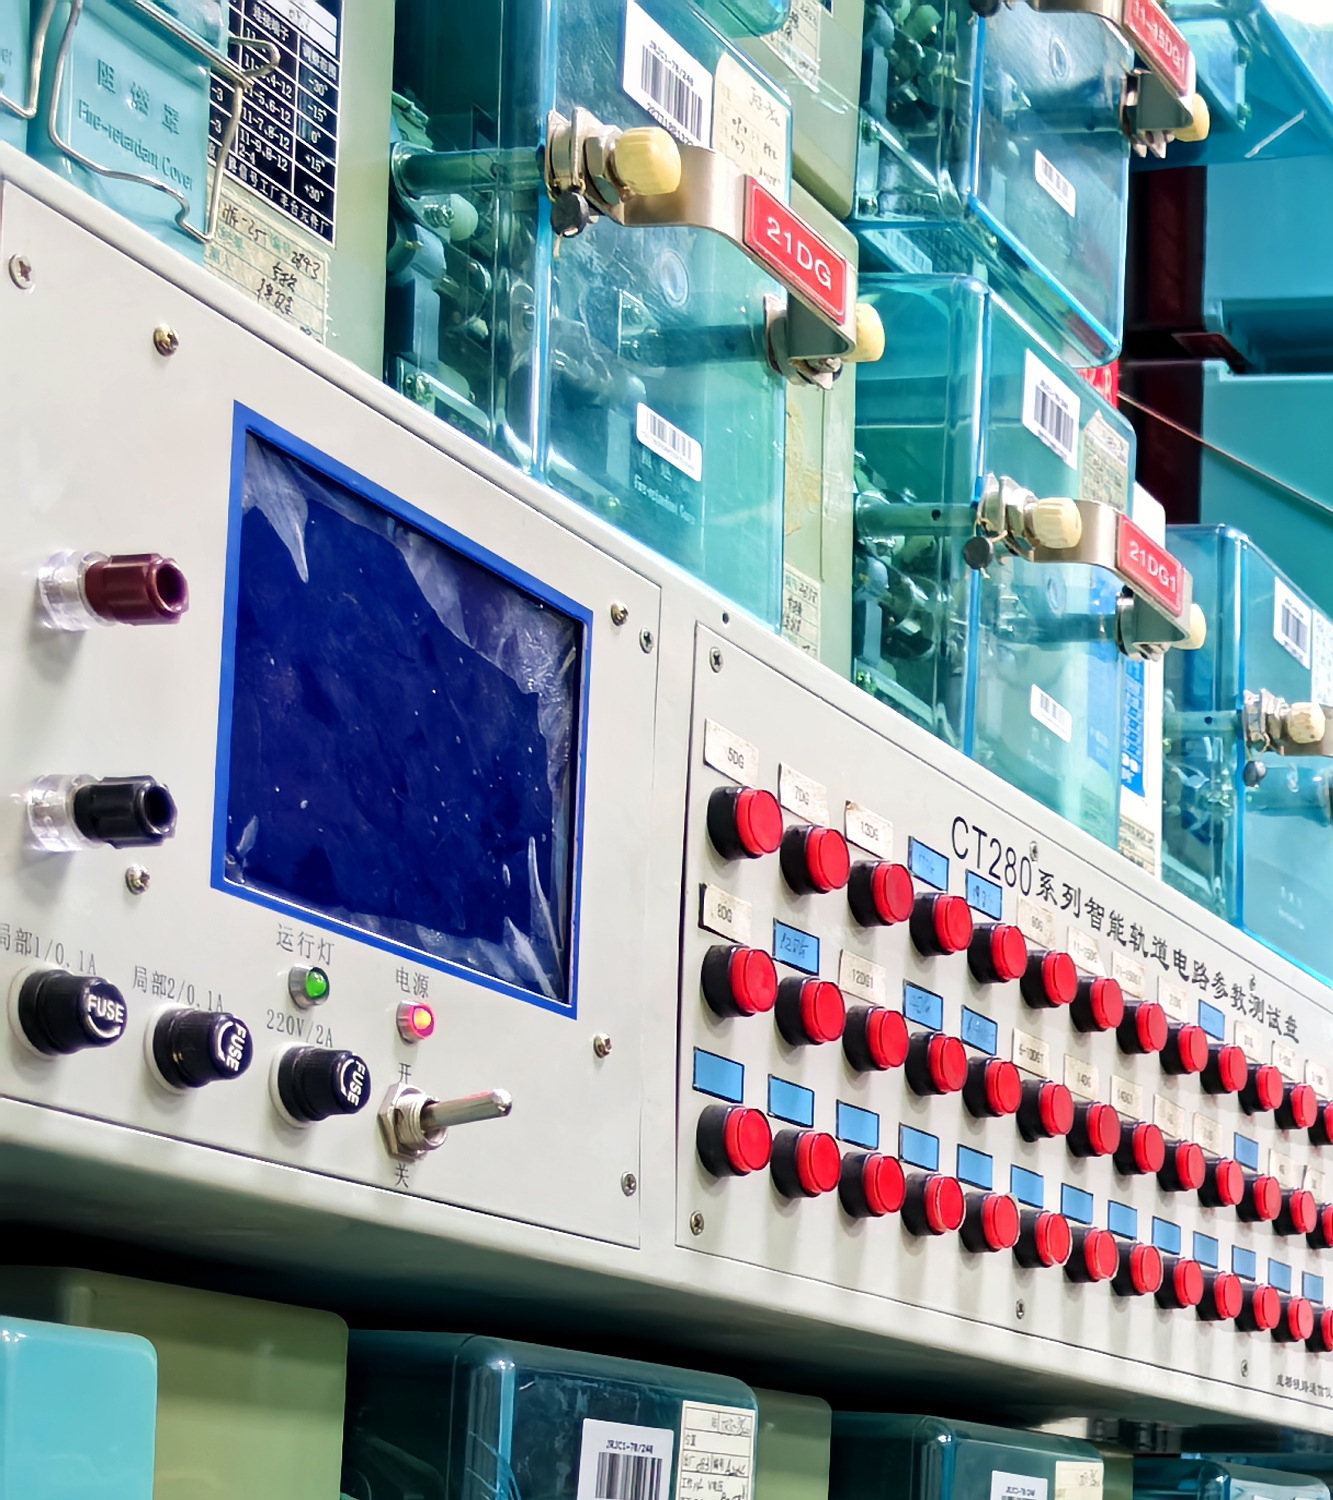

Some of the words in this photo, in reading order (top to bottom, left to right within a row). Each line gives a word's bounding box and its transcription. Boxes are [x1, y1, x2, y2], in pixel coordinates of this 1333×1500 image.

[766, 216, 833, 290] 21DG
[1129, 540, 1177, 593] 21DG1
[727, 748, 745, 770] 5DG
[276, 922, 335, 967] 运行灯
[396, 966, 429, 999] 电源
[86, 994, 125, 1024] FUSE
[266, 1009, 333, 1049] 220V/2A
[225, 1022, 247, 1072] FUSE
[347, 1060, 366, 1107] FUSE
[399, 1062, 412, 1084] 开
[394, 1164, 409, 1189] 关
